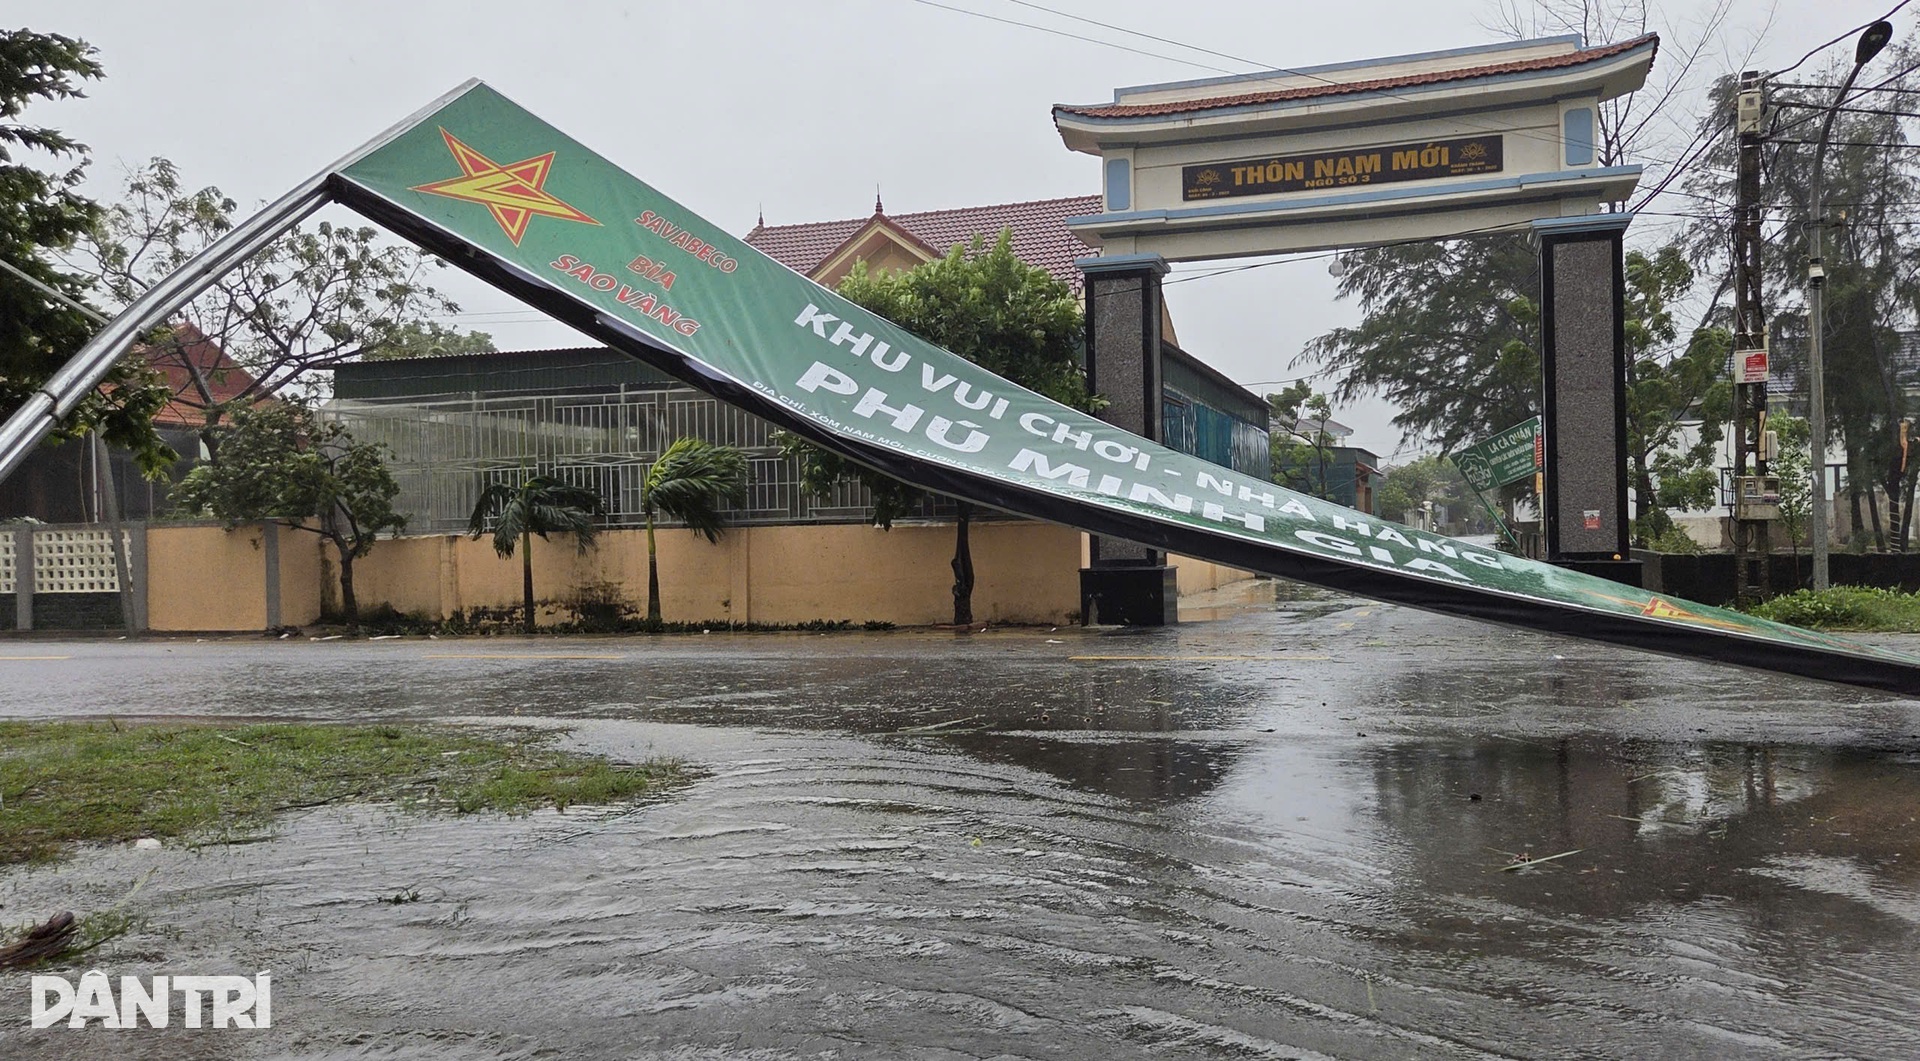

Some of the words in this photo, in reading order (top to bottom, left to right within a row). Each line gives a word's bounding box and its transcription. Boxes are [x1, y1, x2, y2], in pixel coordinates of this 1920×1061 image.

[1231, 160, 1304, 187] THÔN
[1314, 154, 1382, 179] NAM
[1392, 142, 1449, 171] MỚI
[1339, 174, 1358, 186] SỐ
[1361, 175, 1371, 184] 3
[634, 209, 739, 274] SAVABECO
[550, 254, 618, 292] SAO
[615, 284, 702, 337] VÀNG
[794, 303, 911, 372] KHU
[922, 362, 1010, 420] VUI
[1019, 413, 1151, 471] CHƠI
[1196, 471, 1317, 522] NHÀ
[1333, 515, 1504, 570] HÀNG
[810, 410, 841, 429] XÓM
[843, 425, 875, 440] NAM
[1487, 442, 1500, 453] LA
[1498, 435, 1511, 449] CÀ
[1508, 427, 1532, 445] QUÁN
[795, 361, 990, 453] PHÚ
[1008, 448, 1265, 532] MINH
[1294, 530, 1474, 581] GIA
